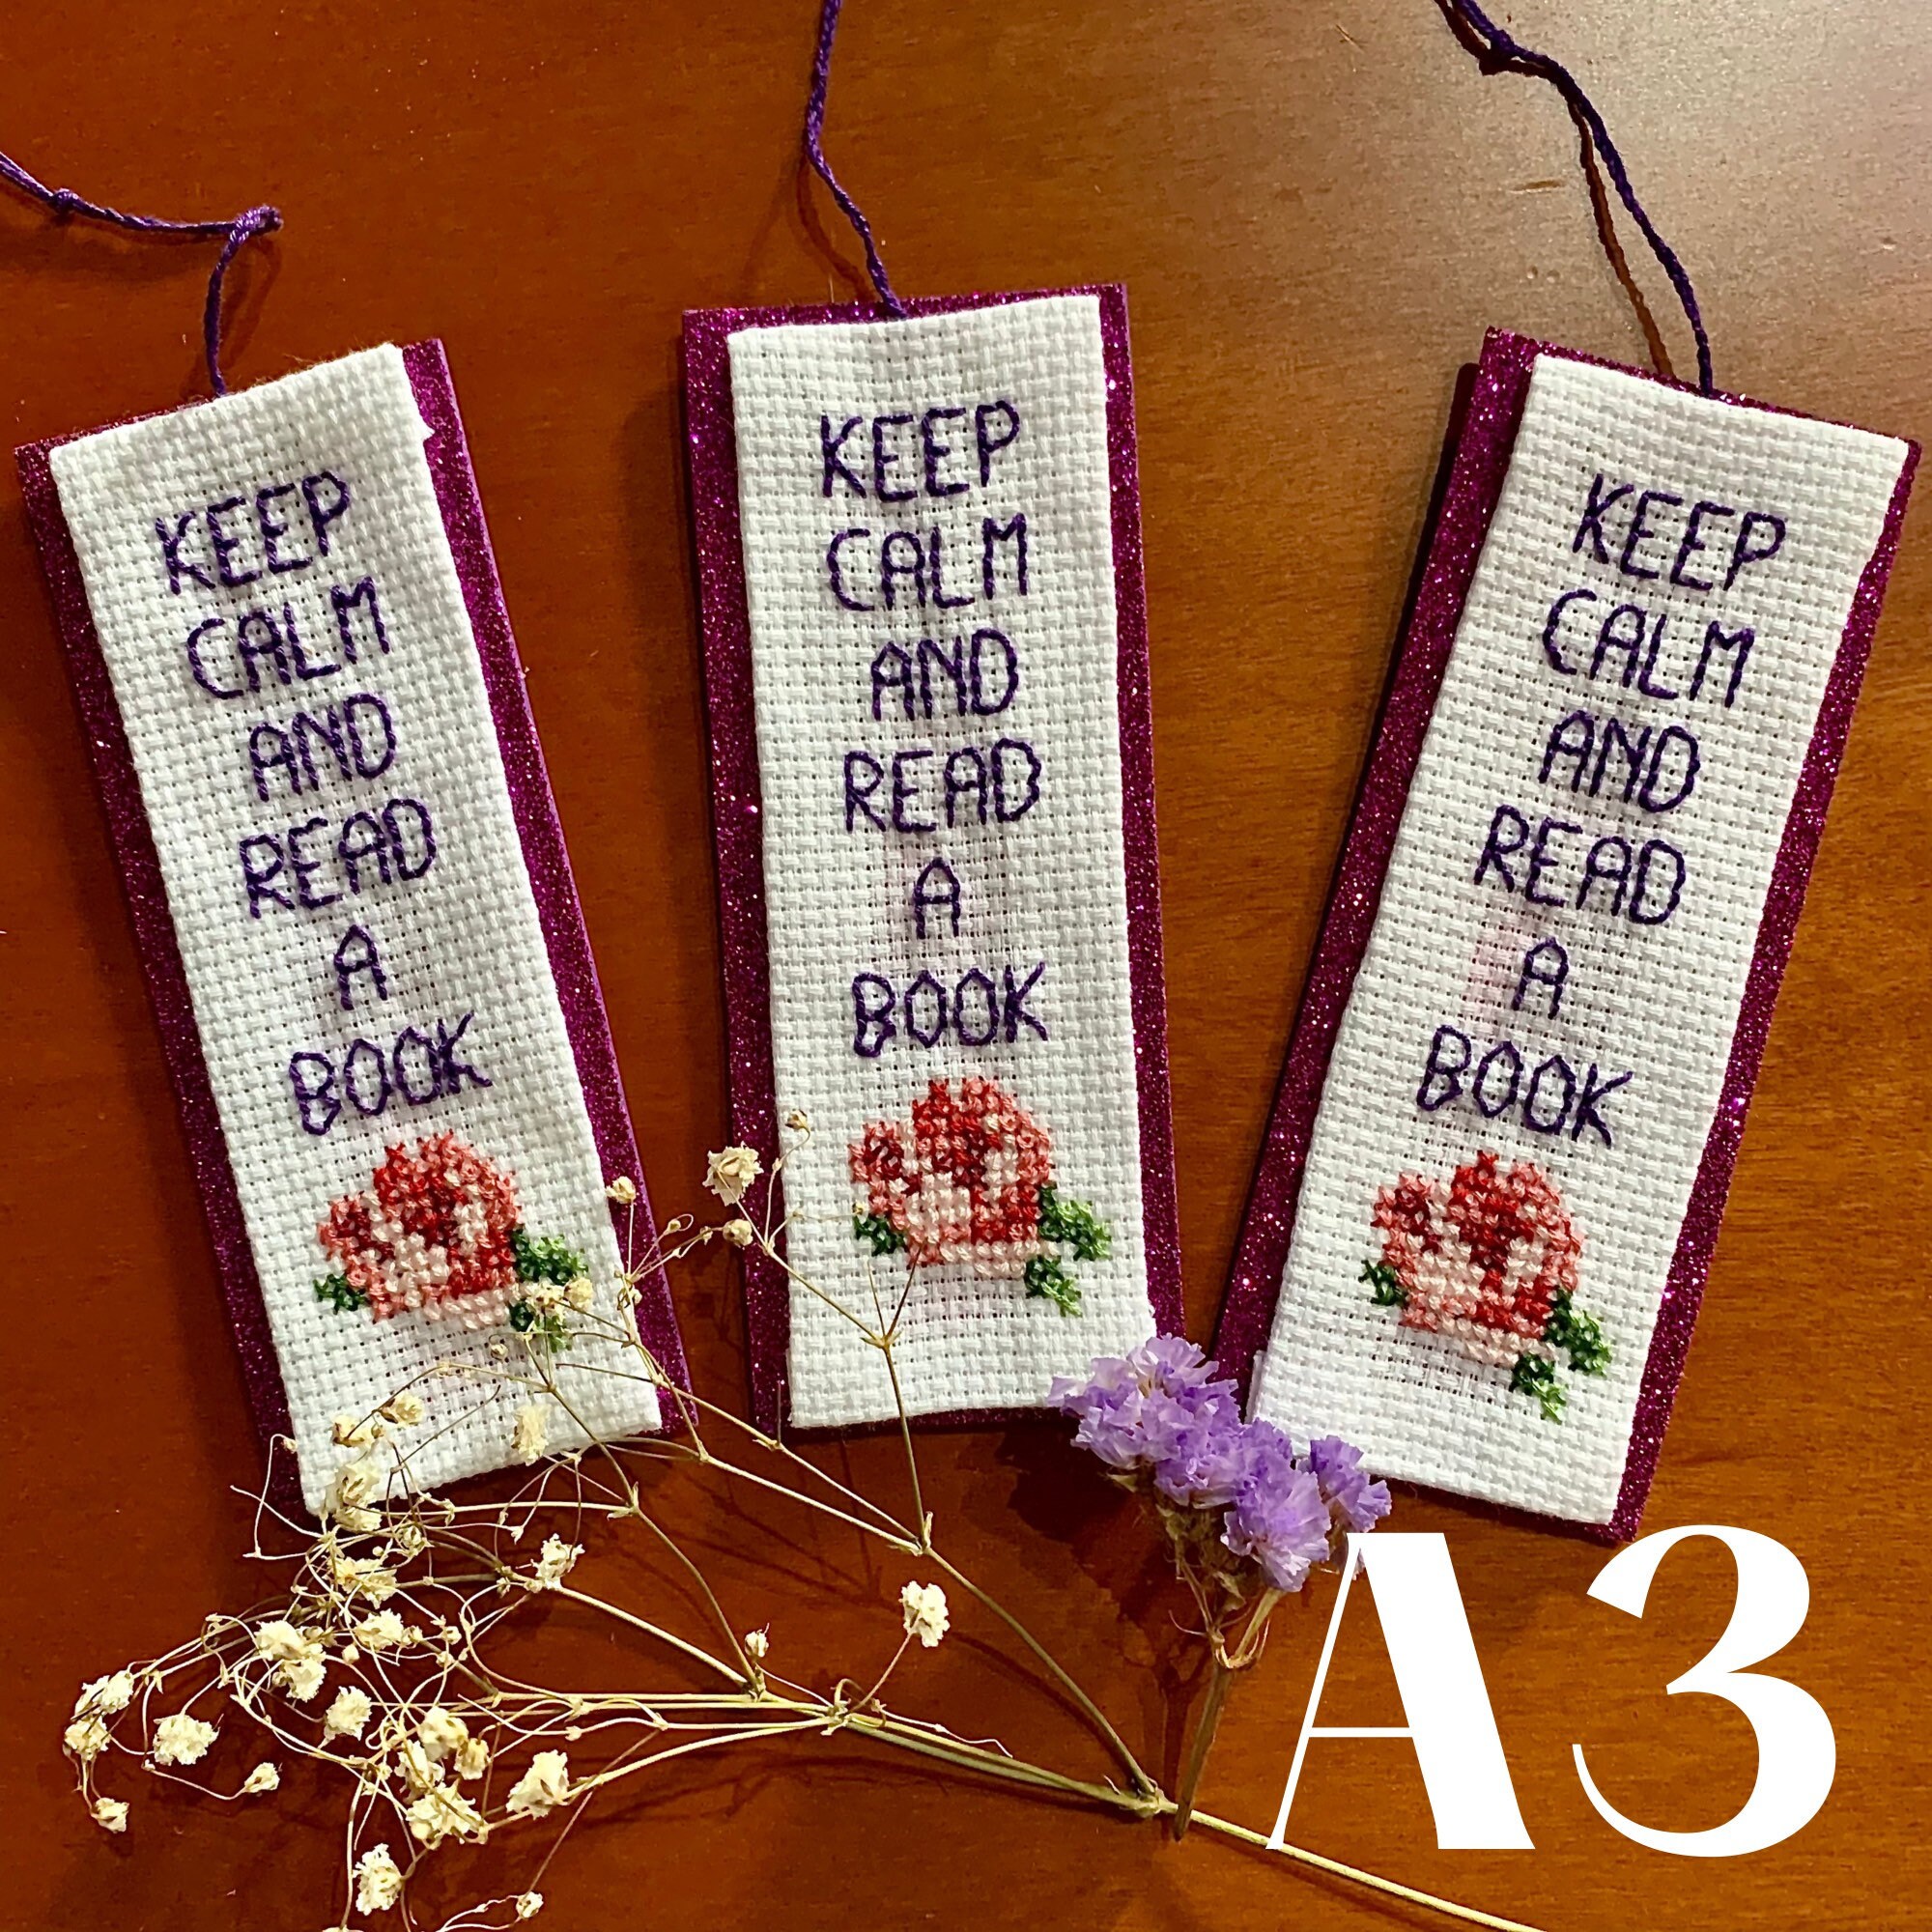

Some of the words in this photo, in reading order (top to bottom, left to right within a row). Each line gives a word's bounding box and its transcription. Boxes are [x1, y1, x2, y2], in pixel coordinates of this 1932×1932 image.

[821, 401, 1020, 501] KEEP
[156, 471, 350, 594] KEEP
[827, 514, 1028, 611] CALM
[1572, 474, 1786, 590] KEEP
[187, 577, 389, 699] CALM
[871, 629, 1018, 721] AND
[1544, 588, 1755, 708] CALM
[250, 693, 398, 802] AND
[844, 738, 1041, 834] READ
[1539, 710, 1700, 813] AND
[240, 798, 436, 919] READ
[913, 858, 960, 939] A
[1474, 804, 1686, 924] READ
[335, 924, 386, 1010] A
[852, 962, 1047, 1058] BOOK
[1512, 938, 1569, 1019] A
[290, 1009, 493, 1135] BOOK
[1417, 1025, 1634, 1145] BOOK
